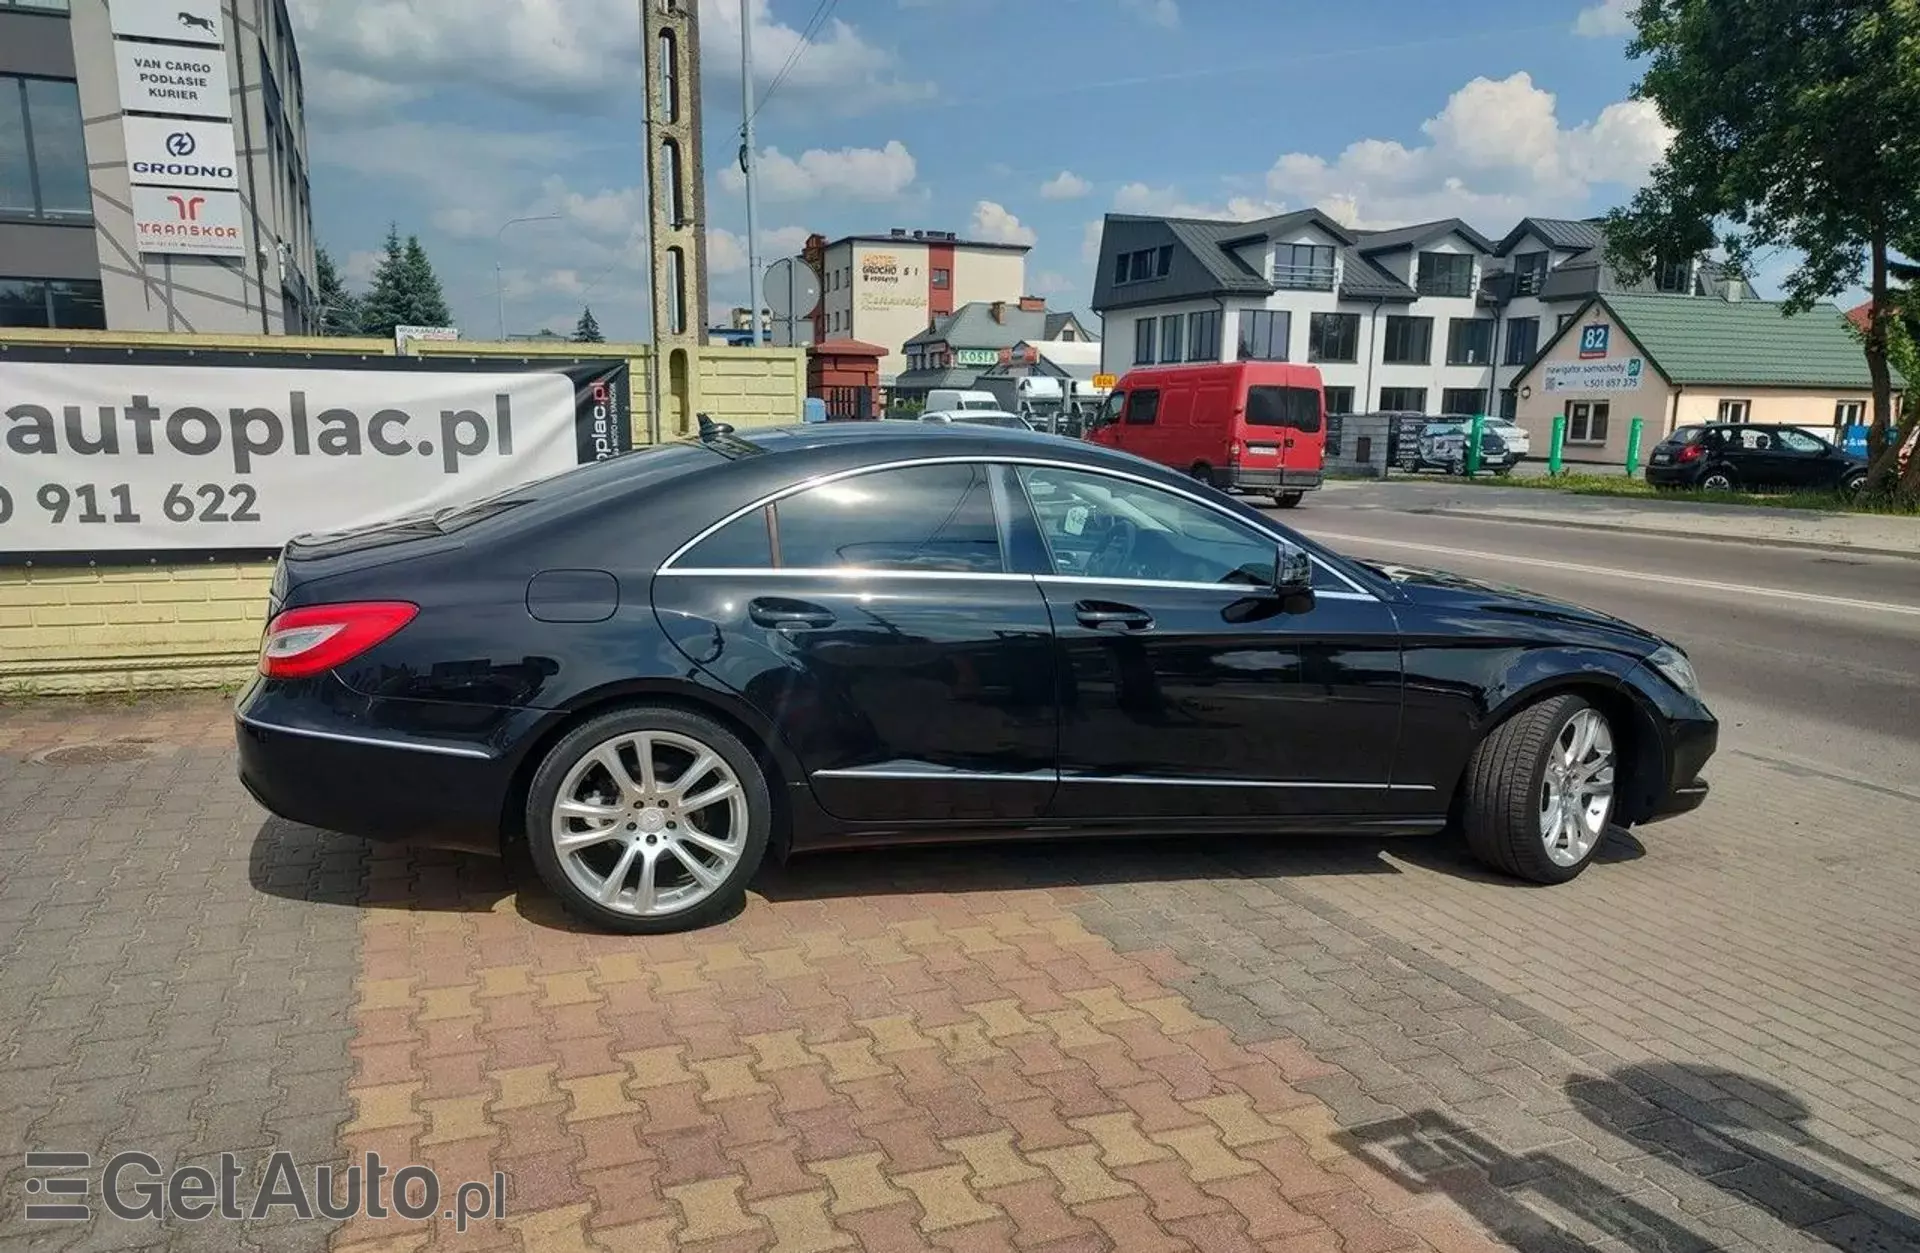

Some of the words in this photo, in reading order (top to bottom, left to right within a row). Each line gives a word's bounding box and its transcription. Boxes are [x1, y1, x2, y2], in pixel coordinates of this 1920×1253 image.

[134, 58, 161, 69] VAN
[165, 61, 211, 73] CARGO
[139, 72, 207, 87] PODLASIE
[148, 87, 198, 101] KURIER
[132, 161, 233, 179] GRODNO
[137, 223, 237, 239] TRANSKOR
[1585, 329, 1605, 349] 82
[4, 391, 514, 474] autoplac.pl
[36, 483, 140, 523] 911
[163, 483, 261, 522] 622
